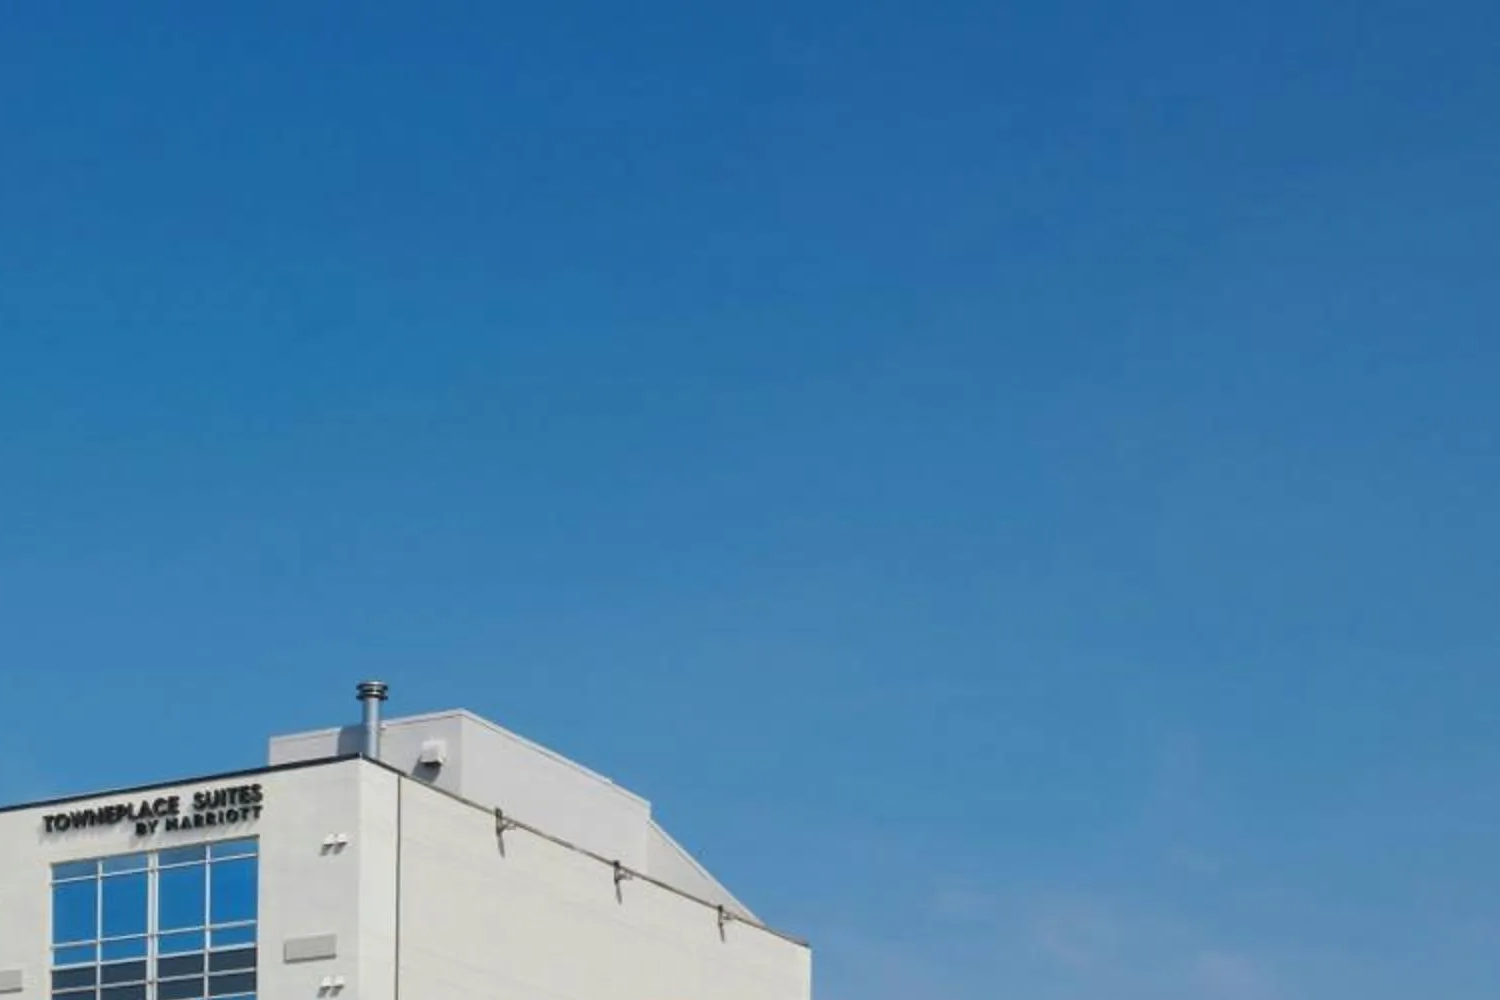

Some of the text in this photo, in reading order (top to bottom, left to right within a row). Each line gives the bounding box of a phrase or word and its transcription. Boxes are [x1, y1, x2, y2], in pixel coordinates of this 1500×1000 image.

[43, 783, 263, 833] TOWNEPLACE SUITES
[135, 805, 263, 836] BY MARRIOTT
